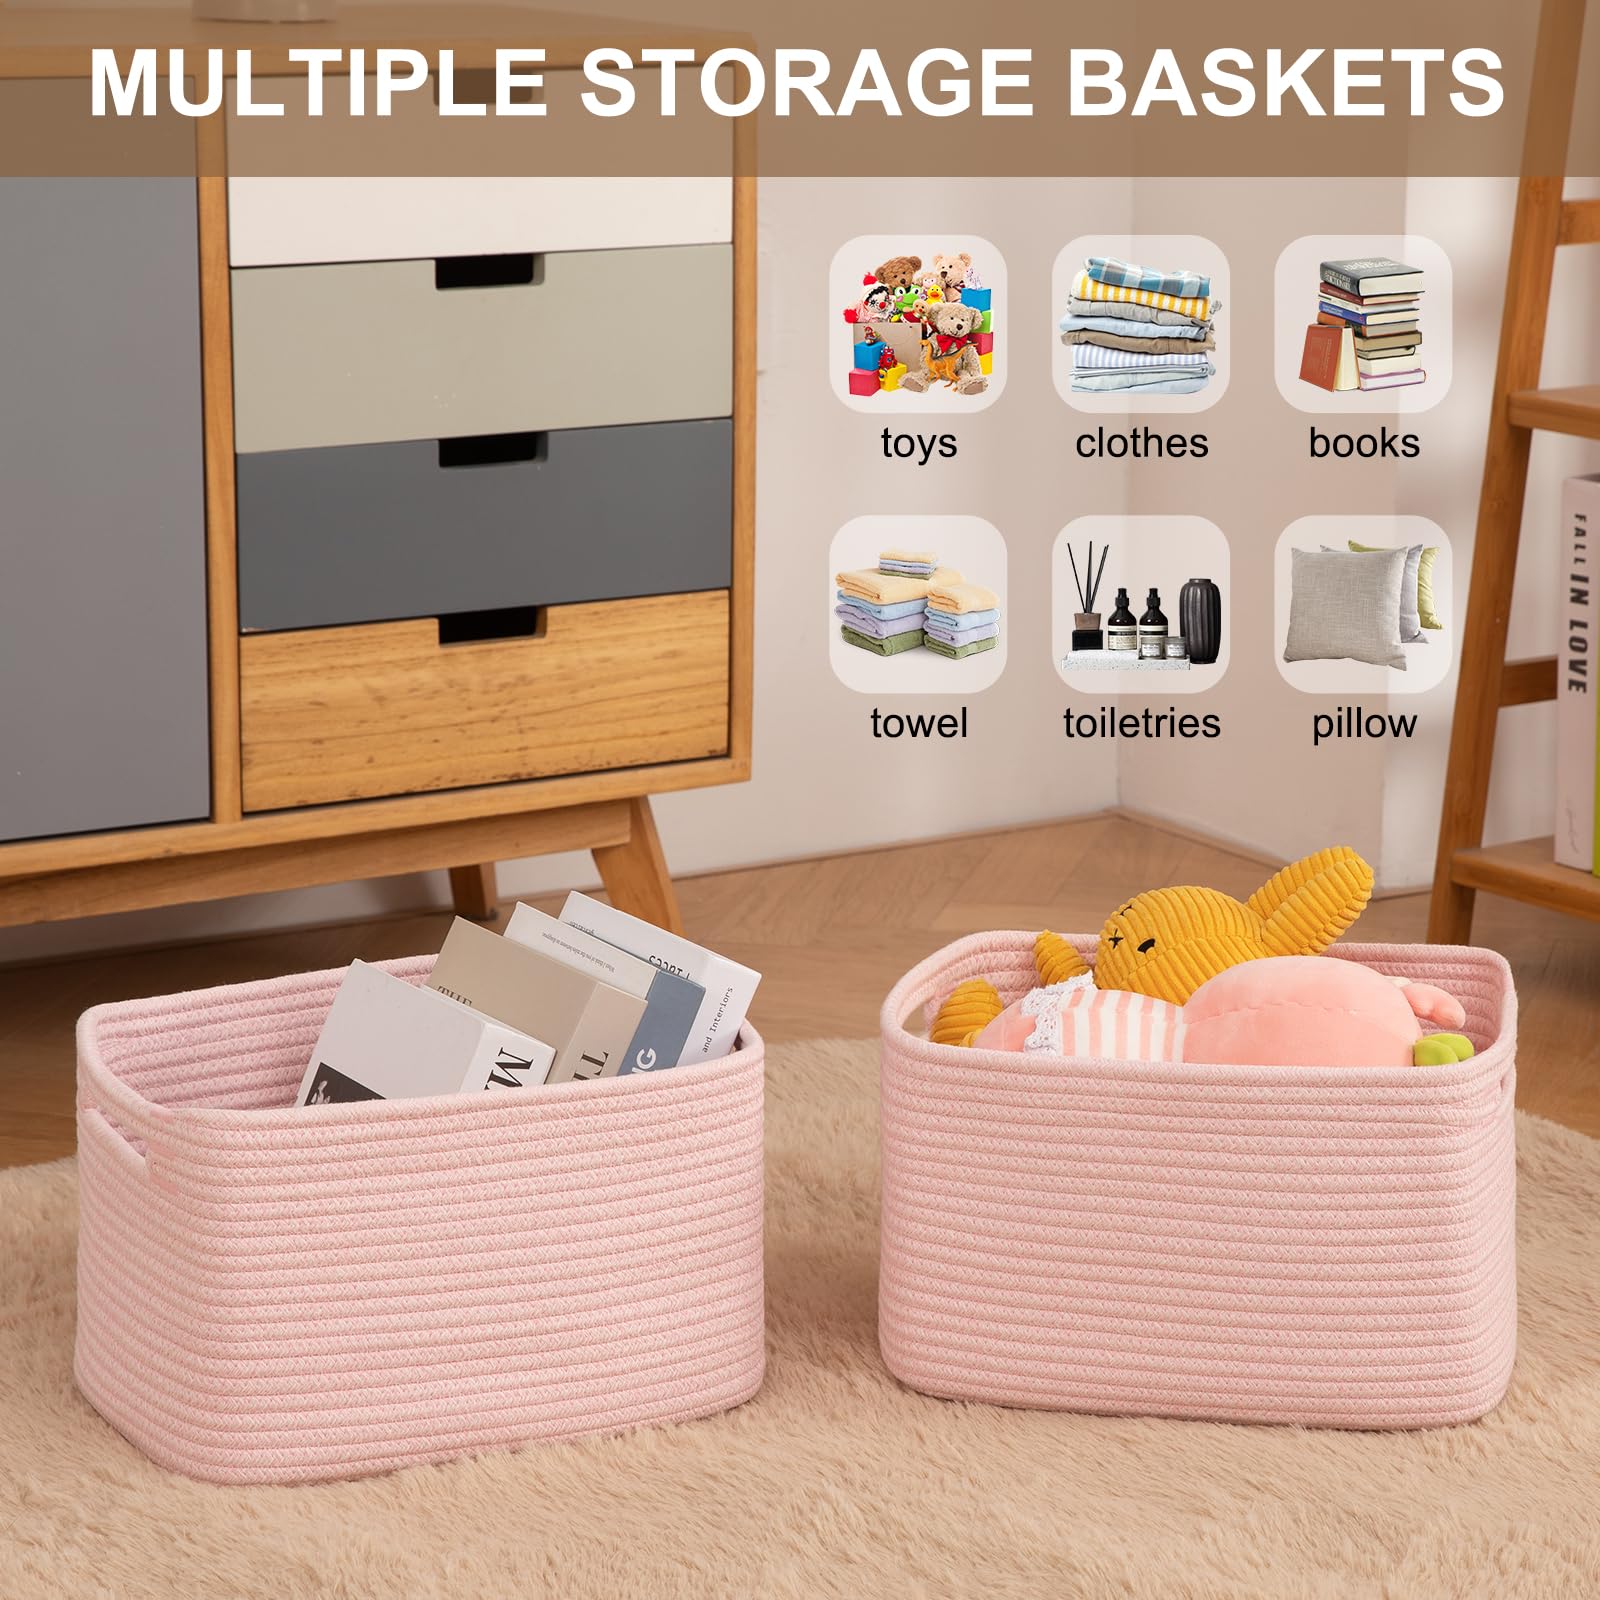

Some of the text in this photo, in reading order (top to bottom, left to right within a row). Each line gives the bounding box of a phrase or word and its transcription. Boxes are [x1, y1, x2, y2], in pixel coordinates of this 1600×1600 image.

[1568, 513, 1589, 694] FALL IN LOVE
[702, 986, 734, 1053] and Interiors
